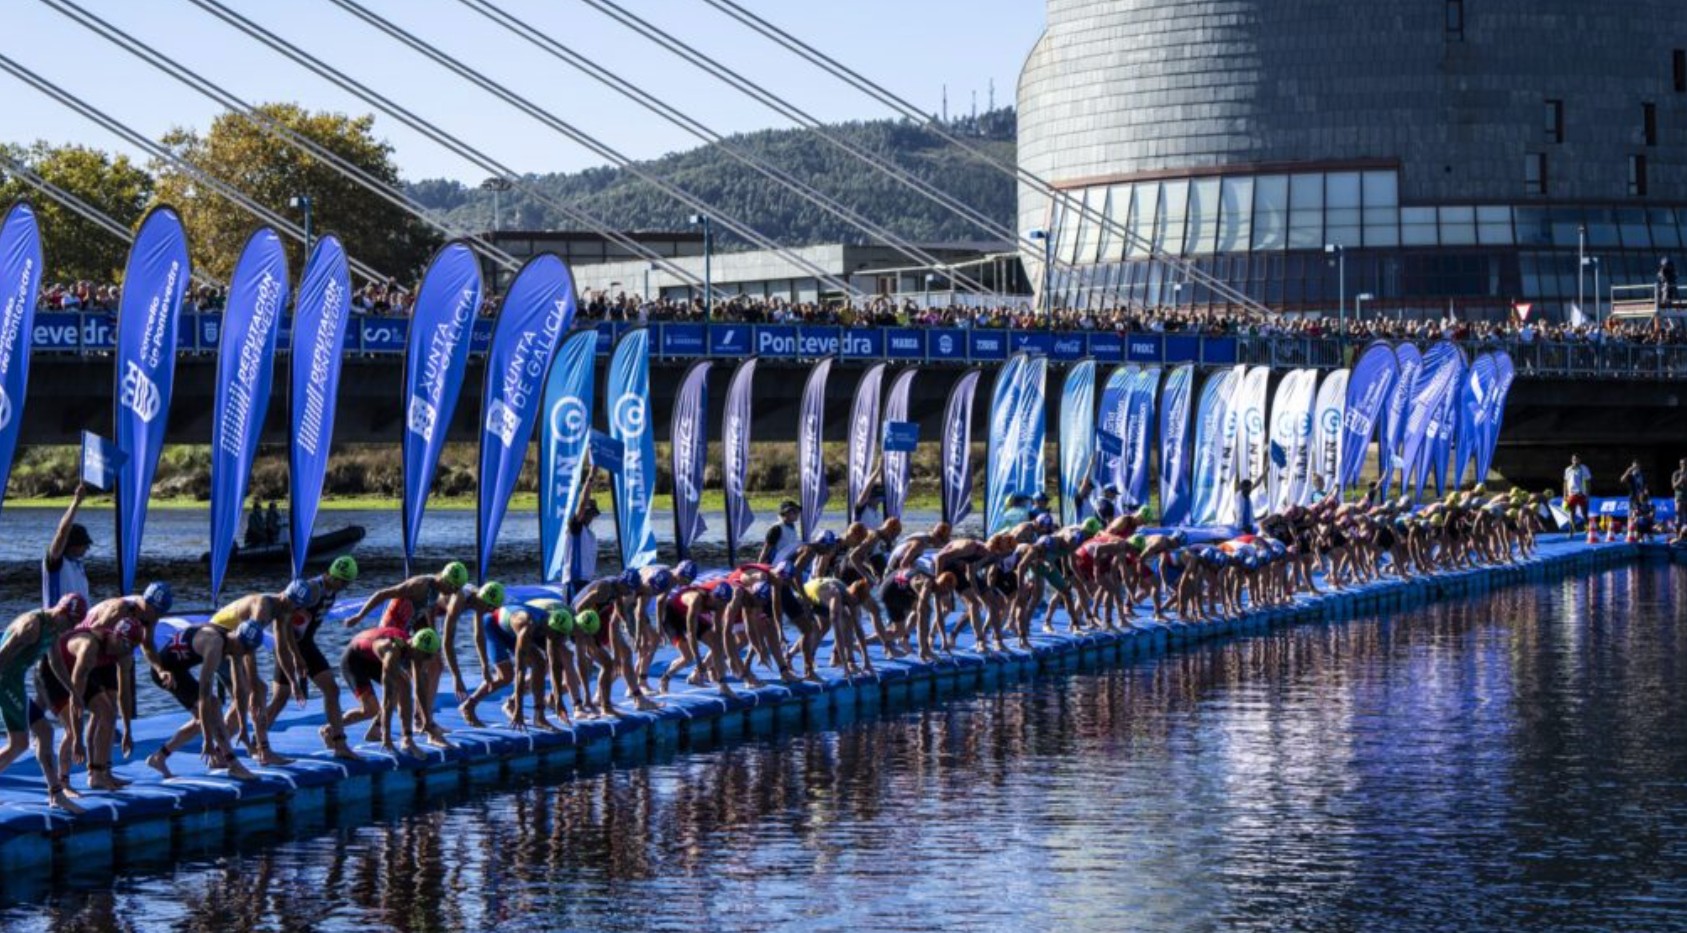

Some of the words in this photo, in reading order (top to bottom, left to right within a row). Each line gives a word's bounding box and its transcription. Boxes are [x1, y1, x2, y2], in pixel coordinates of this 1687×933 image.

[5, 258, 33, 351] Pontevedra
[140, 295, 160, 360] Concello
[153, 260, 179, 347] Pontevedra
[244, 280, 281, 391] PONTEVEDRA
[441, 289, 477, 370] GALICIA
[419, 322, 449, 393] XUNTA
[503, 331, 537, 398] XUNTA
[512, 379, 533, 408] DE
[527, 300, 566, 377] GALICIA
[760, 332, 872, 353] Pontevedra
[1325, 440, 1337, 478] NTT
